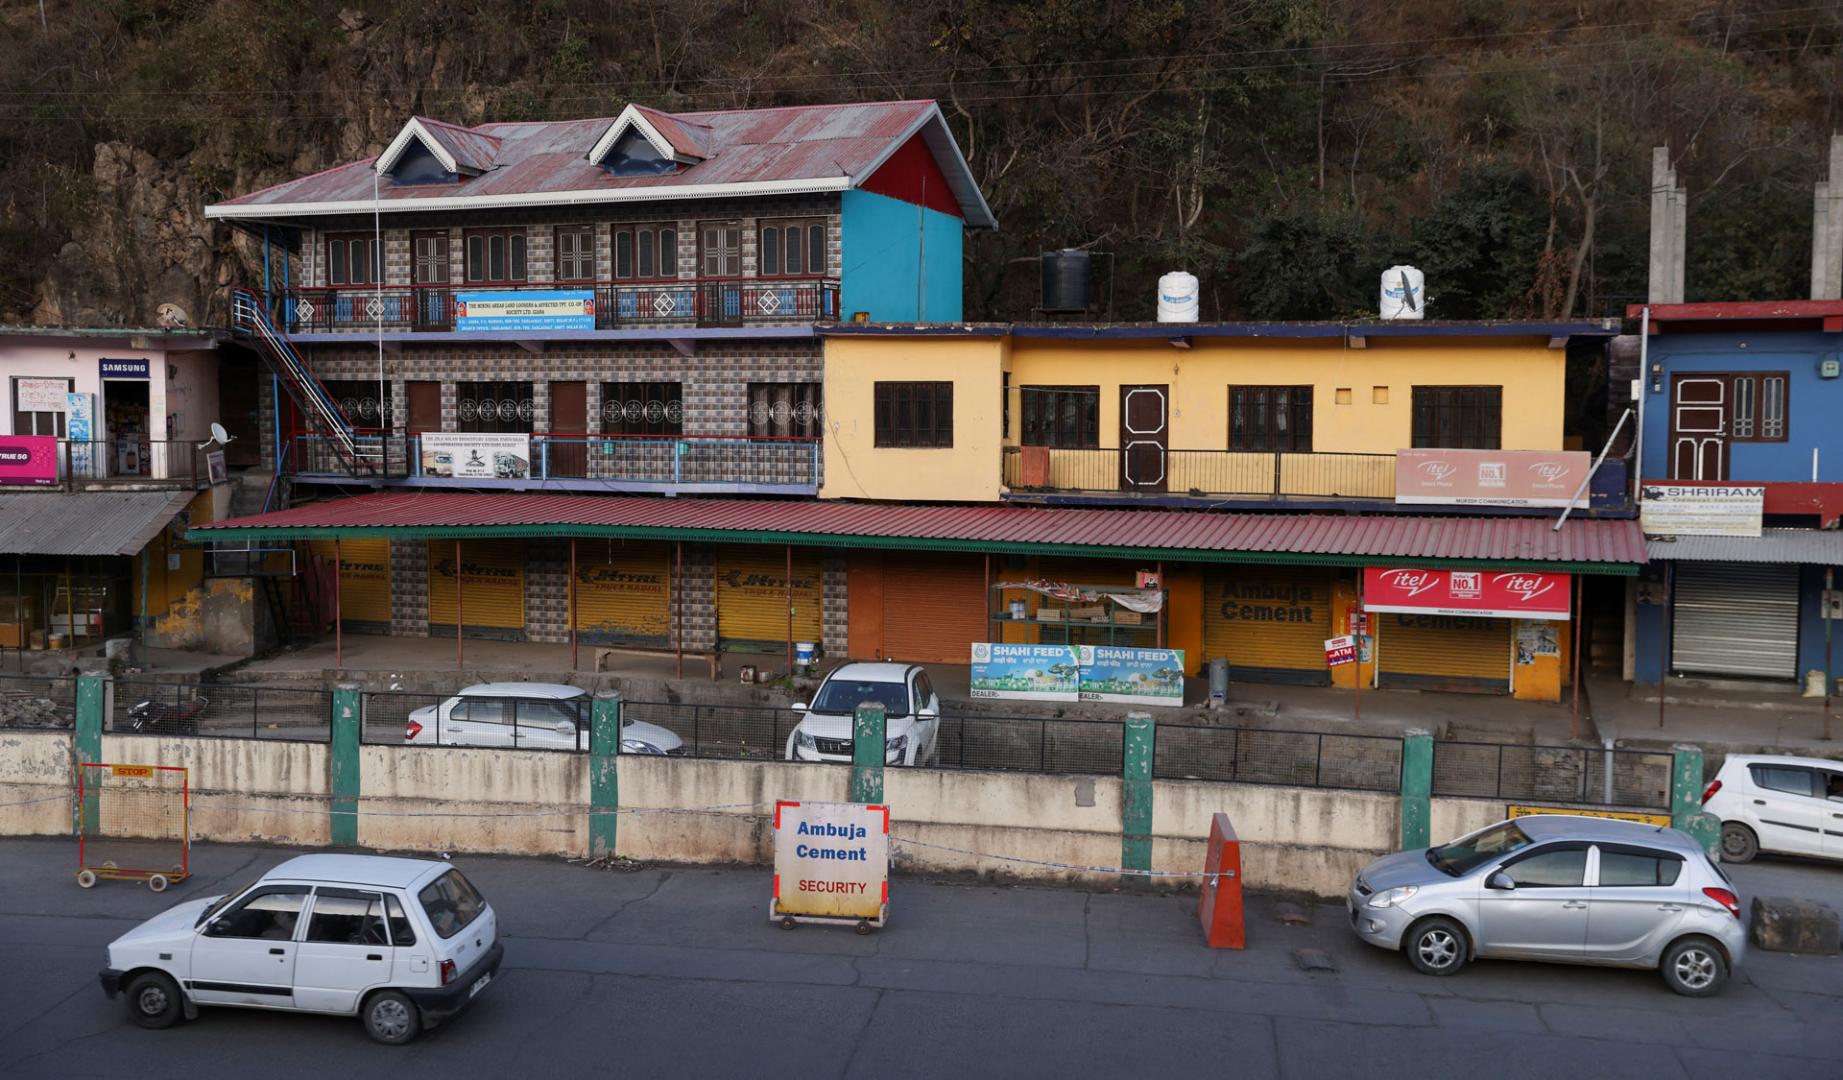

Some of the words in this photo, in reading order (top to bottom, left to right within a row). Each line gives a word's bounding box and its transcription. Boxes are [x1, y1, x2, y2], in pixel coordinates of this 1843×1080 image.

[102, 364, 146, 372] SAMSUNG
[1667, 487, 1764, 497] SHRIRAM
[1221, 601, 1313, 624] Cement
[993, 646, 1031, 657] SHAHI
[1033, 647, 1065, 657] FEED
[1096, 649, 1135, 660] SHAHI
[1137, 651, 1169, 662] FEED
[118, 767, 148, 776] STOP
[797, 821, 867, 840] Ambuja
[796, 844, 867, 861] Cement
[798, 879, 867, 894] SECURITY
